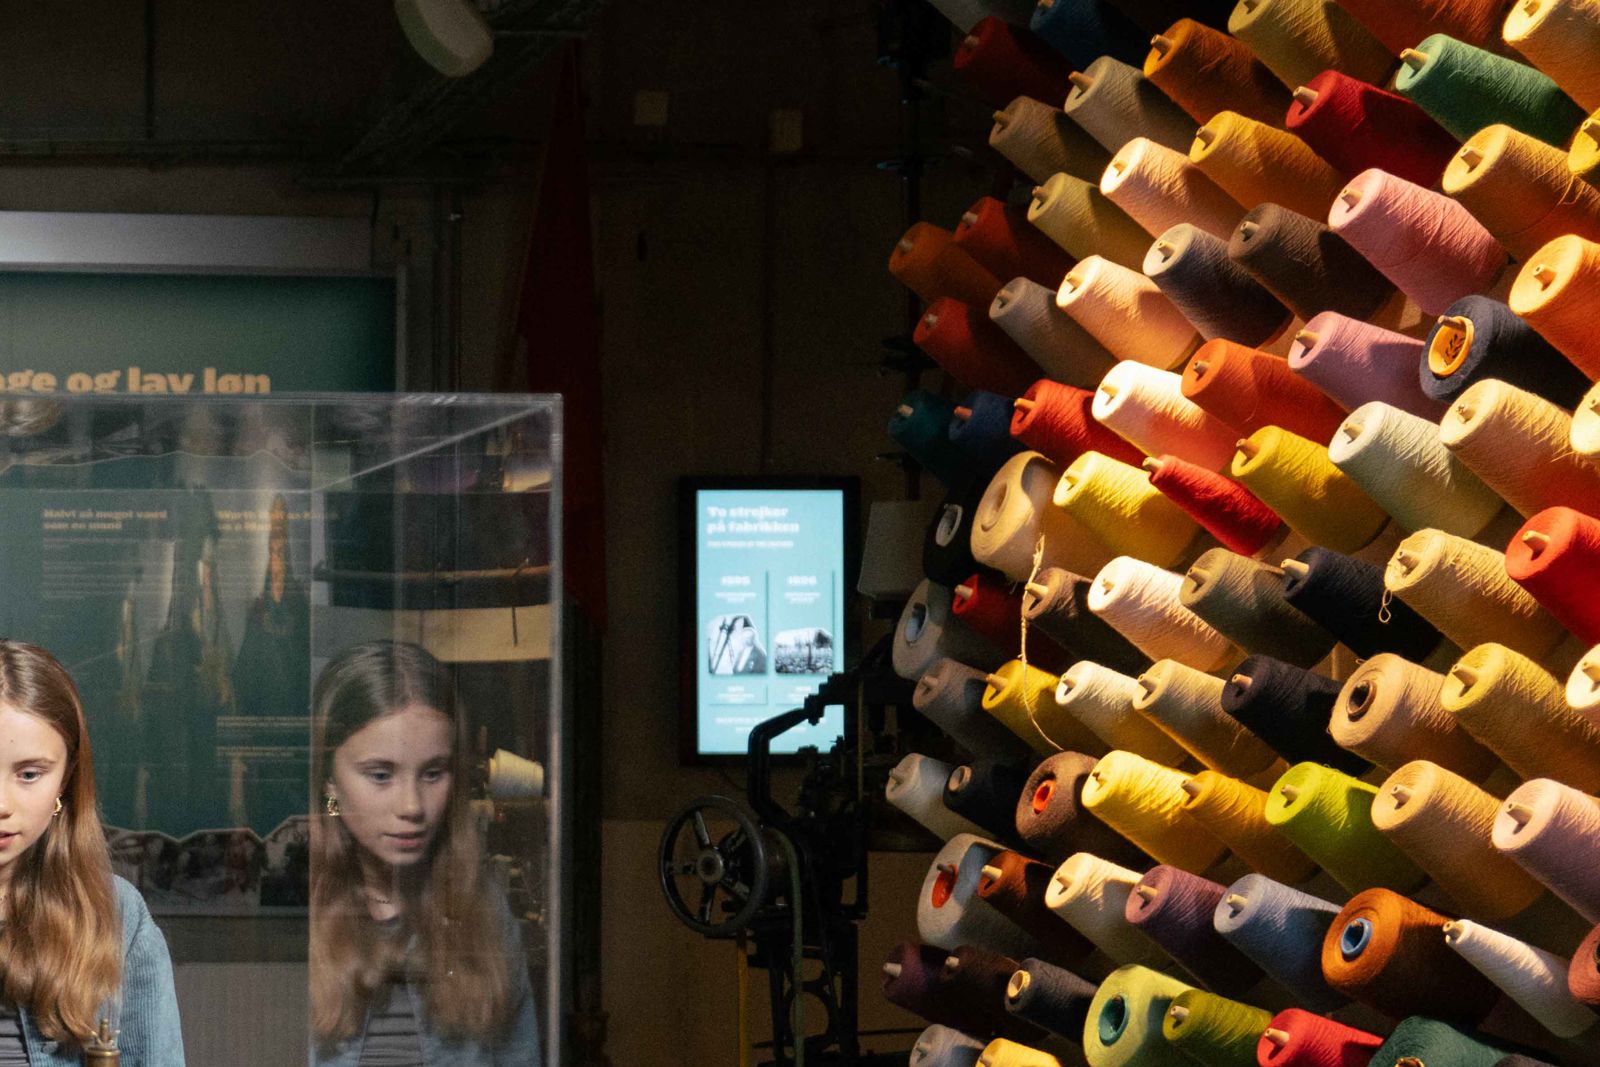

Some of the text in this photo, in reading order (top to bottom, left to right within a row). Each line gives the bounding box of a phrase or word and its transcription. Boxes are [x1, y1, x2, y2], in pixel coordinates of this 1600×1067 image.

[66, 369, 121, 394] og
[128, 366, 194, 395] lav
[204, 366, 271, 395] løn
